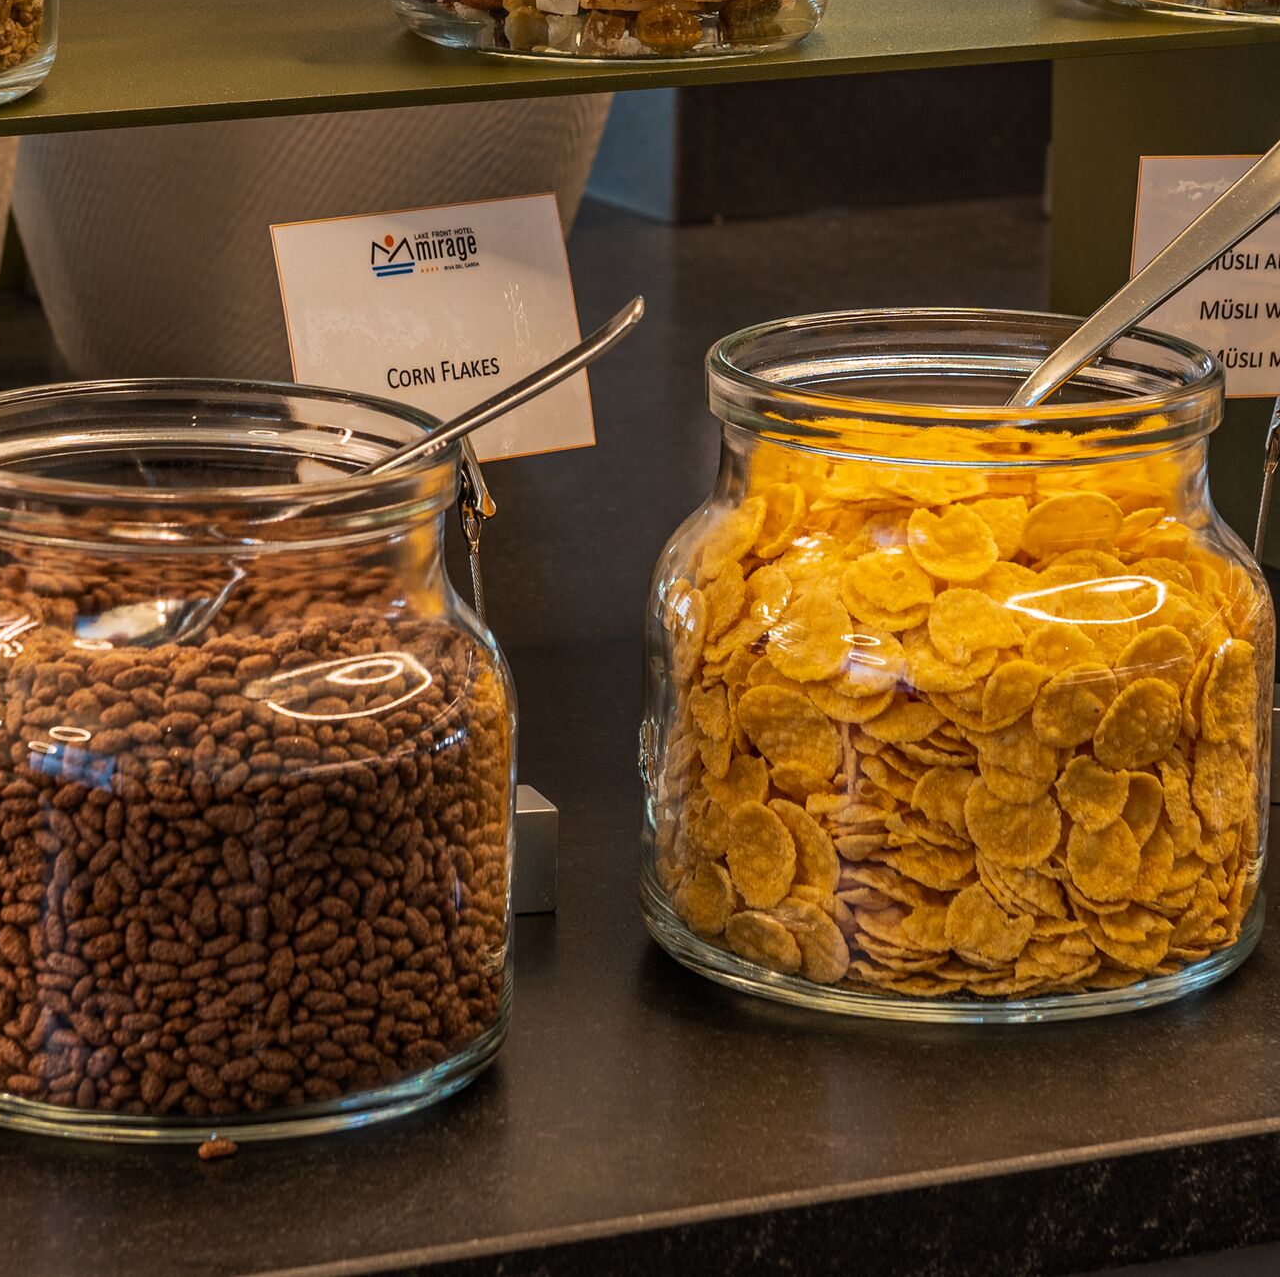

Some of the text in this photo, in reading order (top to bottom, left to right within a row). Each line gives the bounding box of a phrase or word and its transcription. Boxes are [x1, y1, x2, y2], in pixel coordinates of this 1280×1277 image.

[414, 227, 474, 240] LAKE FRONT HOTEL
[415, 235, 477, 261] mirage
